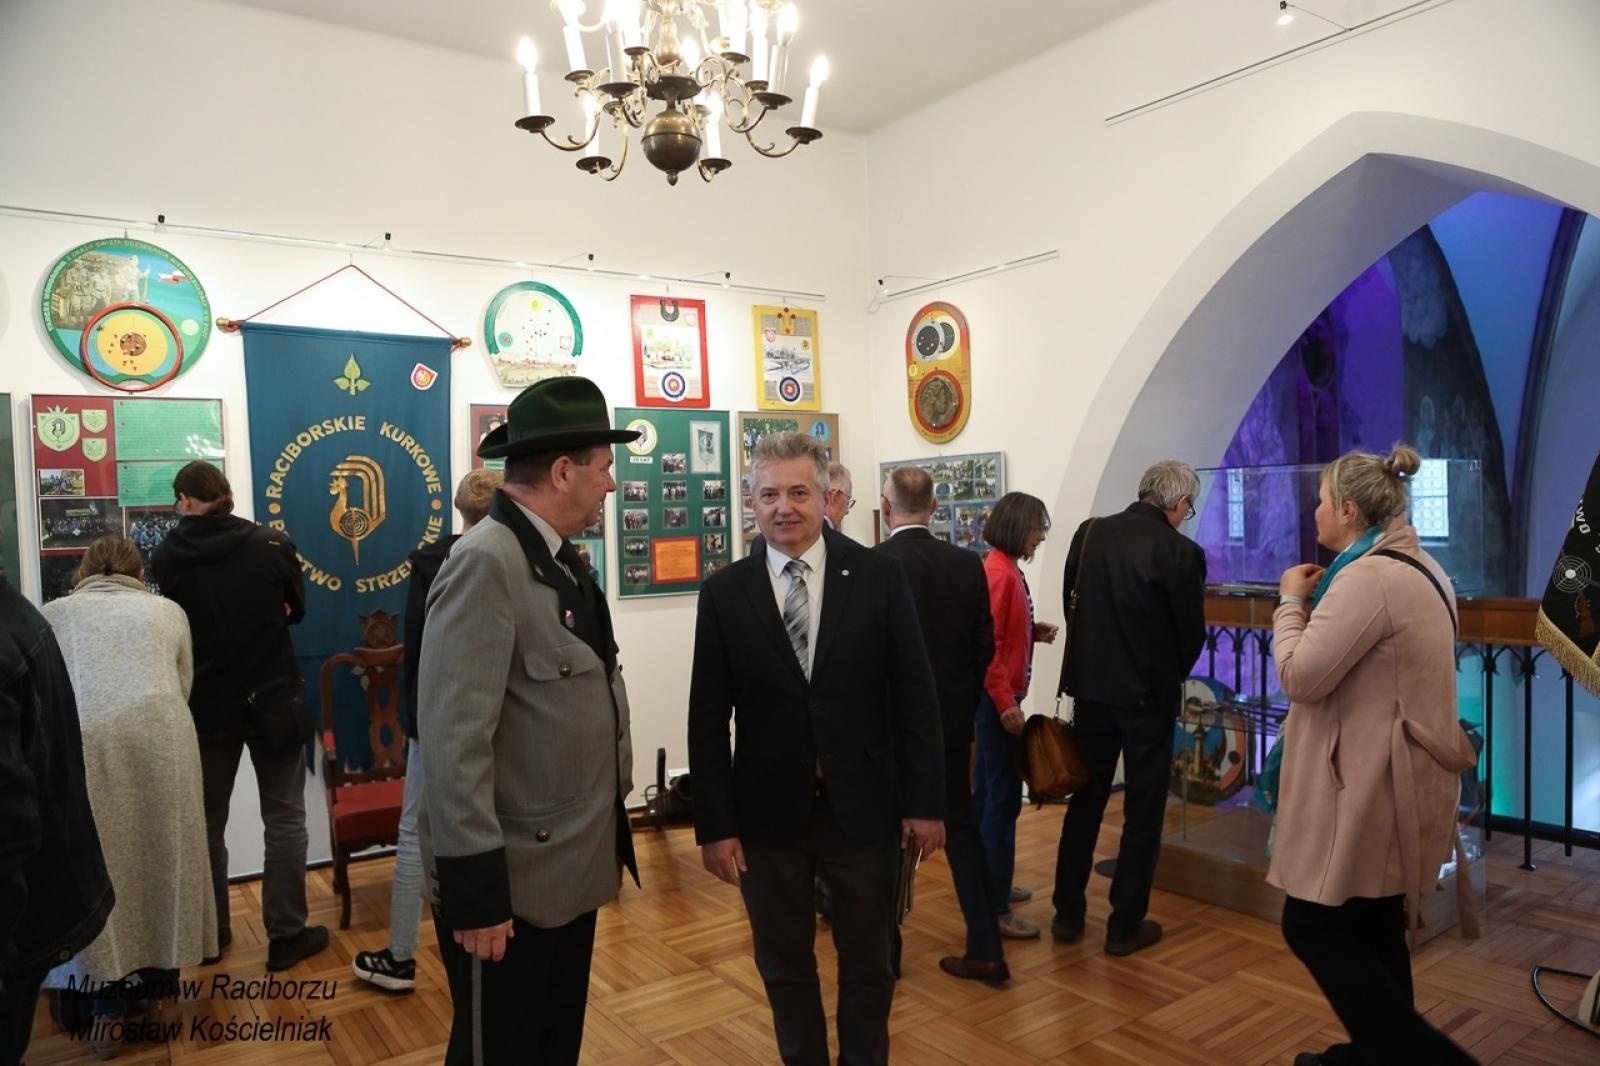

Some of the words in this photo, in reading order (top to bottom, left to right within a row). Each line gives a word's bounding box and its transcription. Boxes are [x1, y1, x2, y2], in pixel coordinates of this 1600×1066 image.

[266, 416, 366, 499] RACIBORSKIE
[380, 422, 442, 494] KURKOWE
[355, 515, 443, 593] STRZEKIE
[1576, 499, 1591, 535] WO
